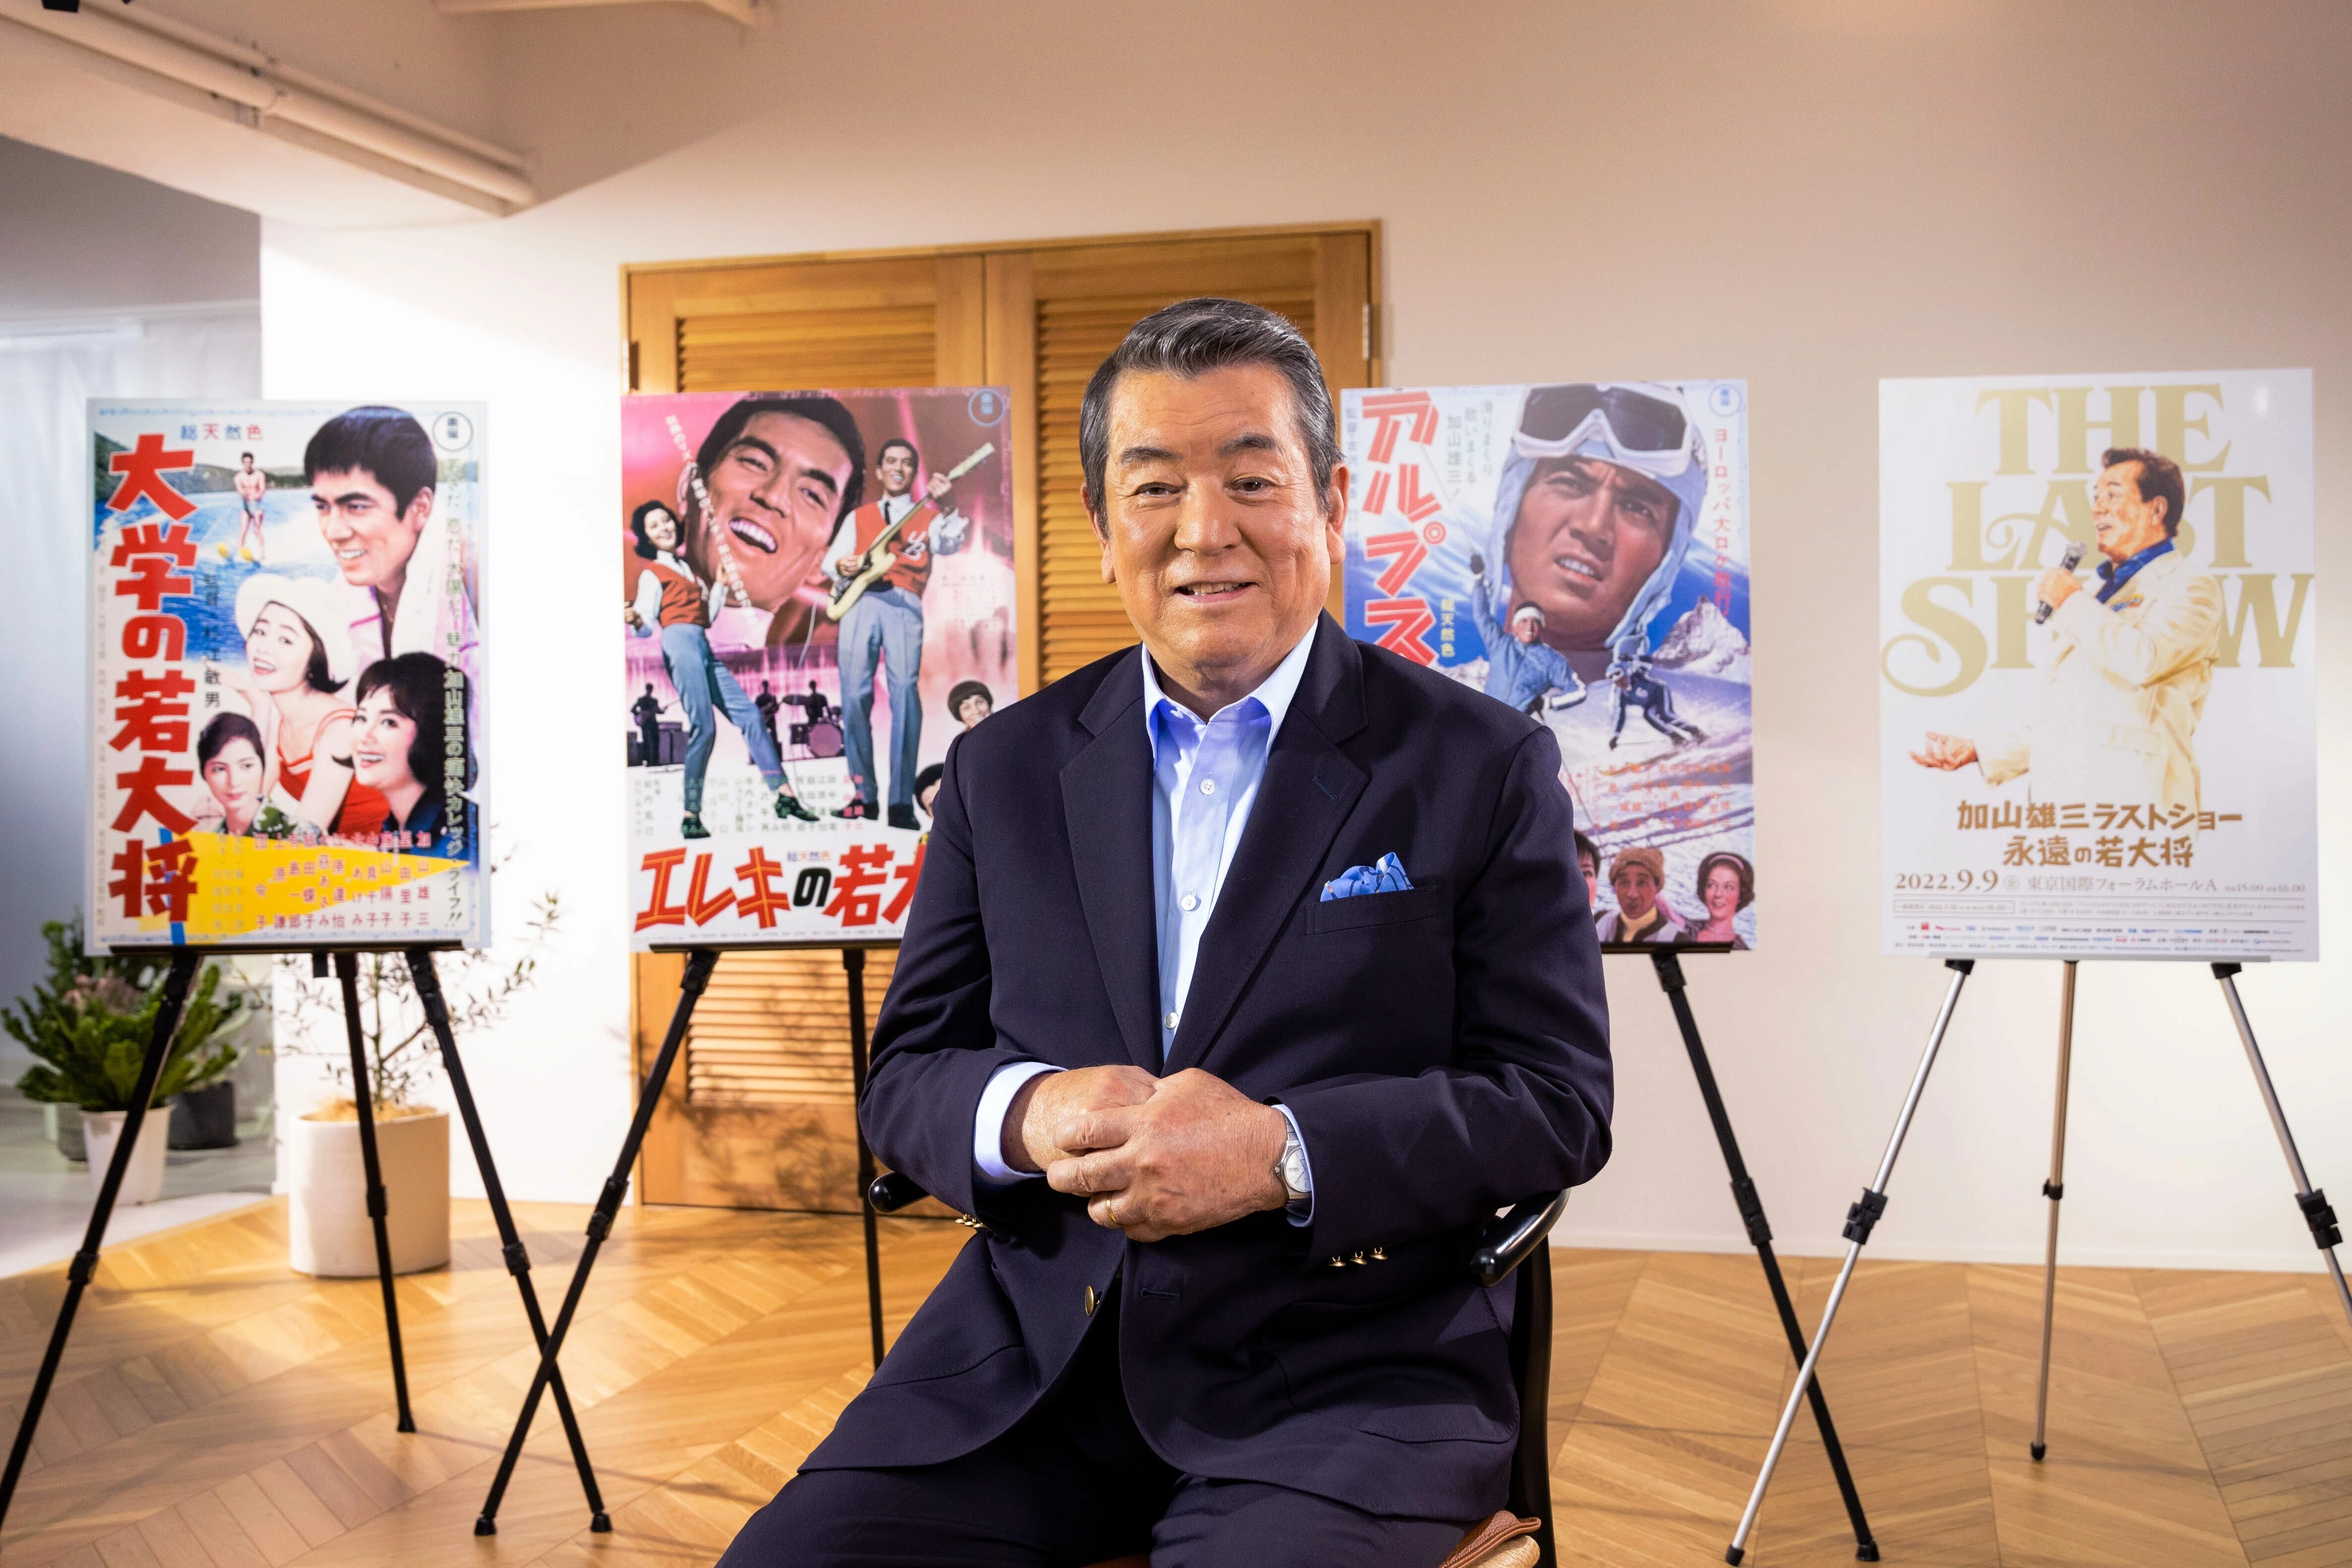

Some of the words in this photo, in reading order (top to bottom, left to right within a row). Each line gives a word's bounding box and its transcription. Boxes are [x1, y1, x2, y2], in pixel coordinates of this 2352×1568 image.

[1975, 383, 2232, 475] THE
[1362, 391, 1446, 666] アルプス
[1946, 476, 2272, 571] LAT
[107, 433, 198, 923] 大学の若大将
[1957, 799, 2243, 830] 加山雄三ラストショー
[2002, 836, 2194, 868] 永遠の若大将
[1894, 869, 1999, 893] 2022.9.9
